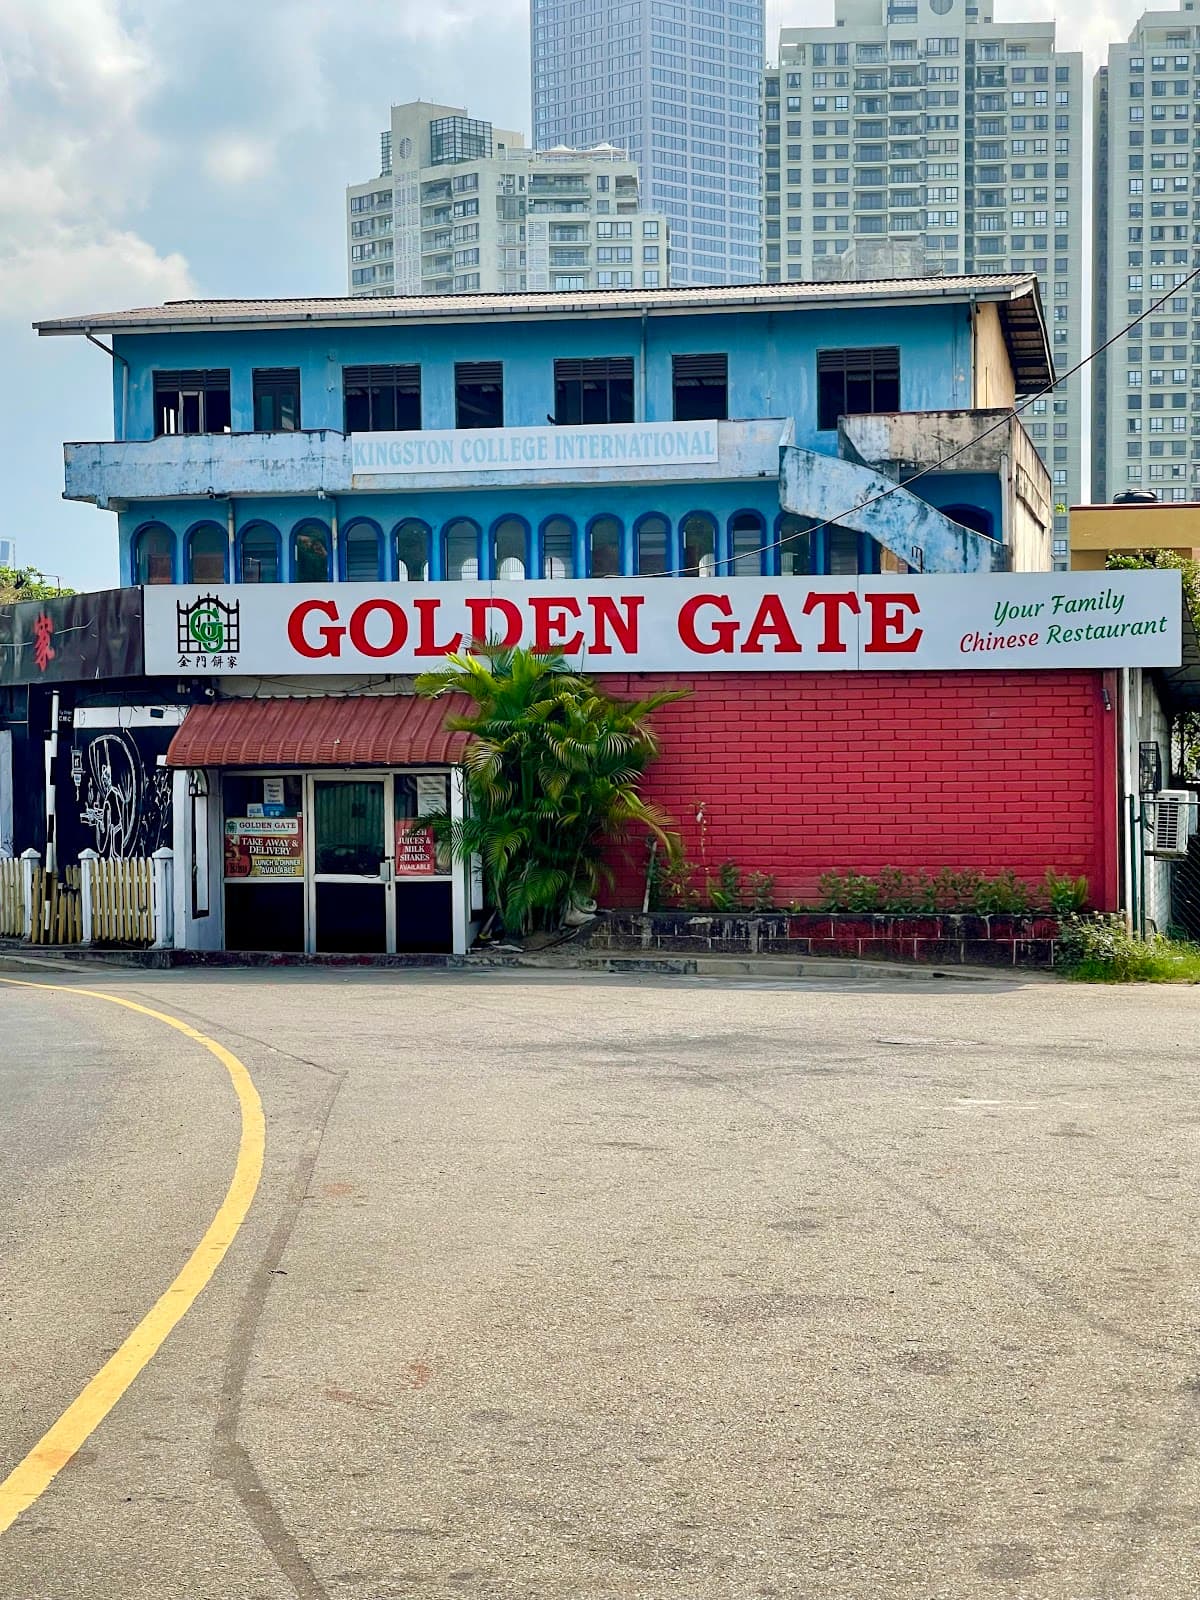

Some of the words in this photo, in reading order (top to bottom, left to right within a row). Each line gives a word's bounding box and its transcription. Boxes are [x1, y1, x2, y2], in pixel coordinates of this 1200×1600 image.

[354, 439, 454, 467] KINGSTON
[460, 435, 548, 463] COLLEGE
[554, 430, 714, 461] INTERNATIONAL
[993, 601, 1045, 628] Your
[1051, 589, 1125, 615] Family
[287, 596, 645, 658] GOLDEN
[678, 593, 923, 653] GATE
[960, 631, 1039, 653] Chinese
[1046, 617, 1168, 644] Restaurant
[239, 821, 272, 829] GOLDEN
[241, 837, 264, 846] TAKE
[265, 838, 290, 847] AWAY
[291, 839, 299, 847] &
[249, 846, 291, 855] DELIVERY
[404, 845, 425, 853] MILK
[399, 854, 430, 862] SHAKES
[261, 866, 296, 874] AVAILABLE
[399, 863, 431, 871] AVAILABLE
